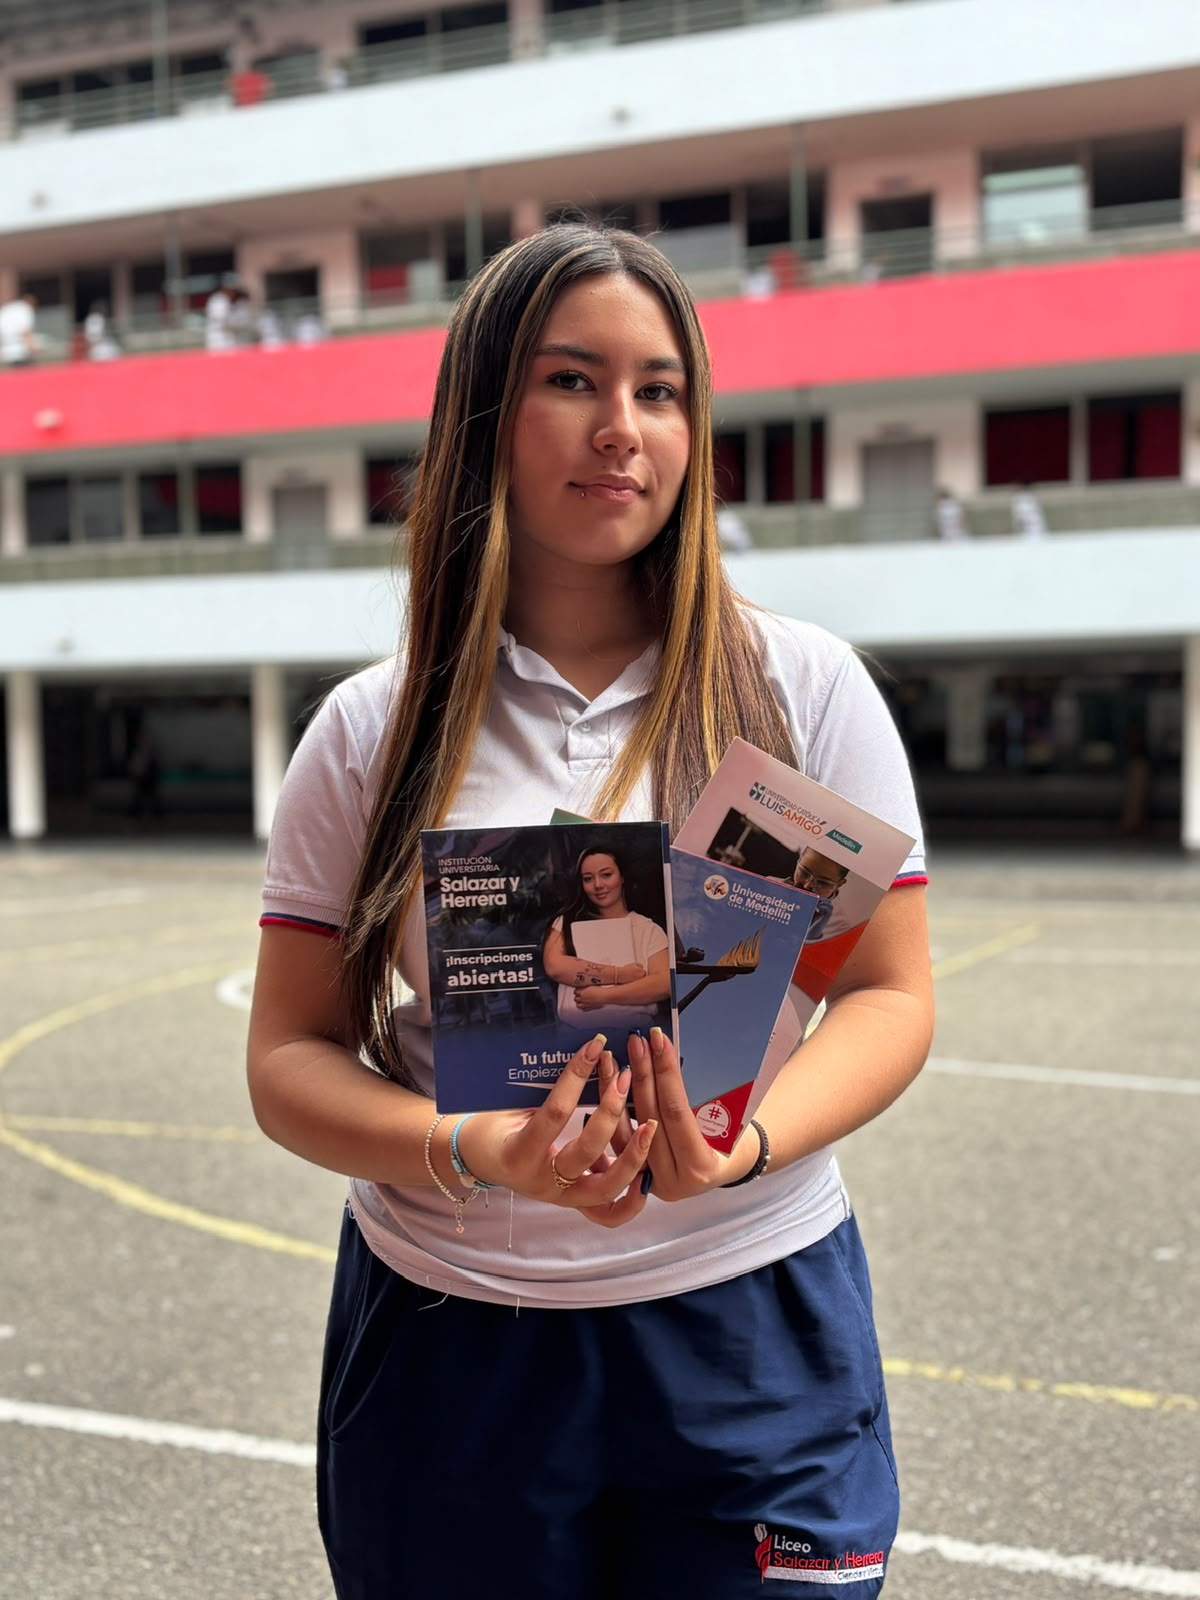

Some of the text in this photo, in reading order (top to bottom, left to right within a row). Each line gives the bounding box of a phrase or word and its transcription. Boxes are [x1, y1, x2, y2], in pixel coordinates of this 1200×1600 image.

[438, 856, 492, 866] INSTITUCIÓN
[439, 864, 500, 874] UNIVERSITARIA
[440, 876, 520, 892] Salazar y
[441, 893, 507, 908] Herrera
[732, 883, 795, 911] Universidad
[729, 894, 791, 920] de Medellín
[446, 952, 533, 967] ¡Inscripciones
[448, 968, 534, 986] abiertas!
[520, 1053, 537, 1065] Tu
[774, 1535, 811, 1553] Liceo
[774, 1551, 884, 1574] Salazar y Herrera
